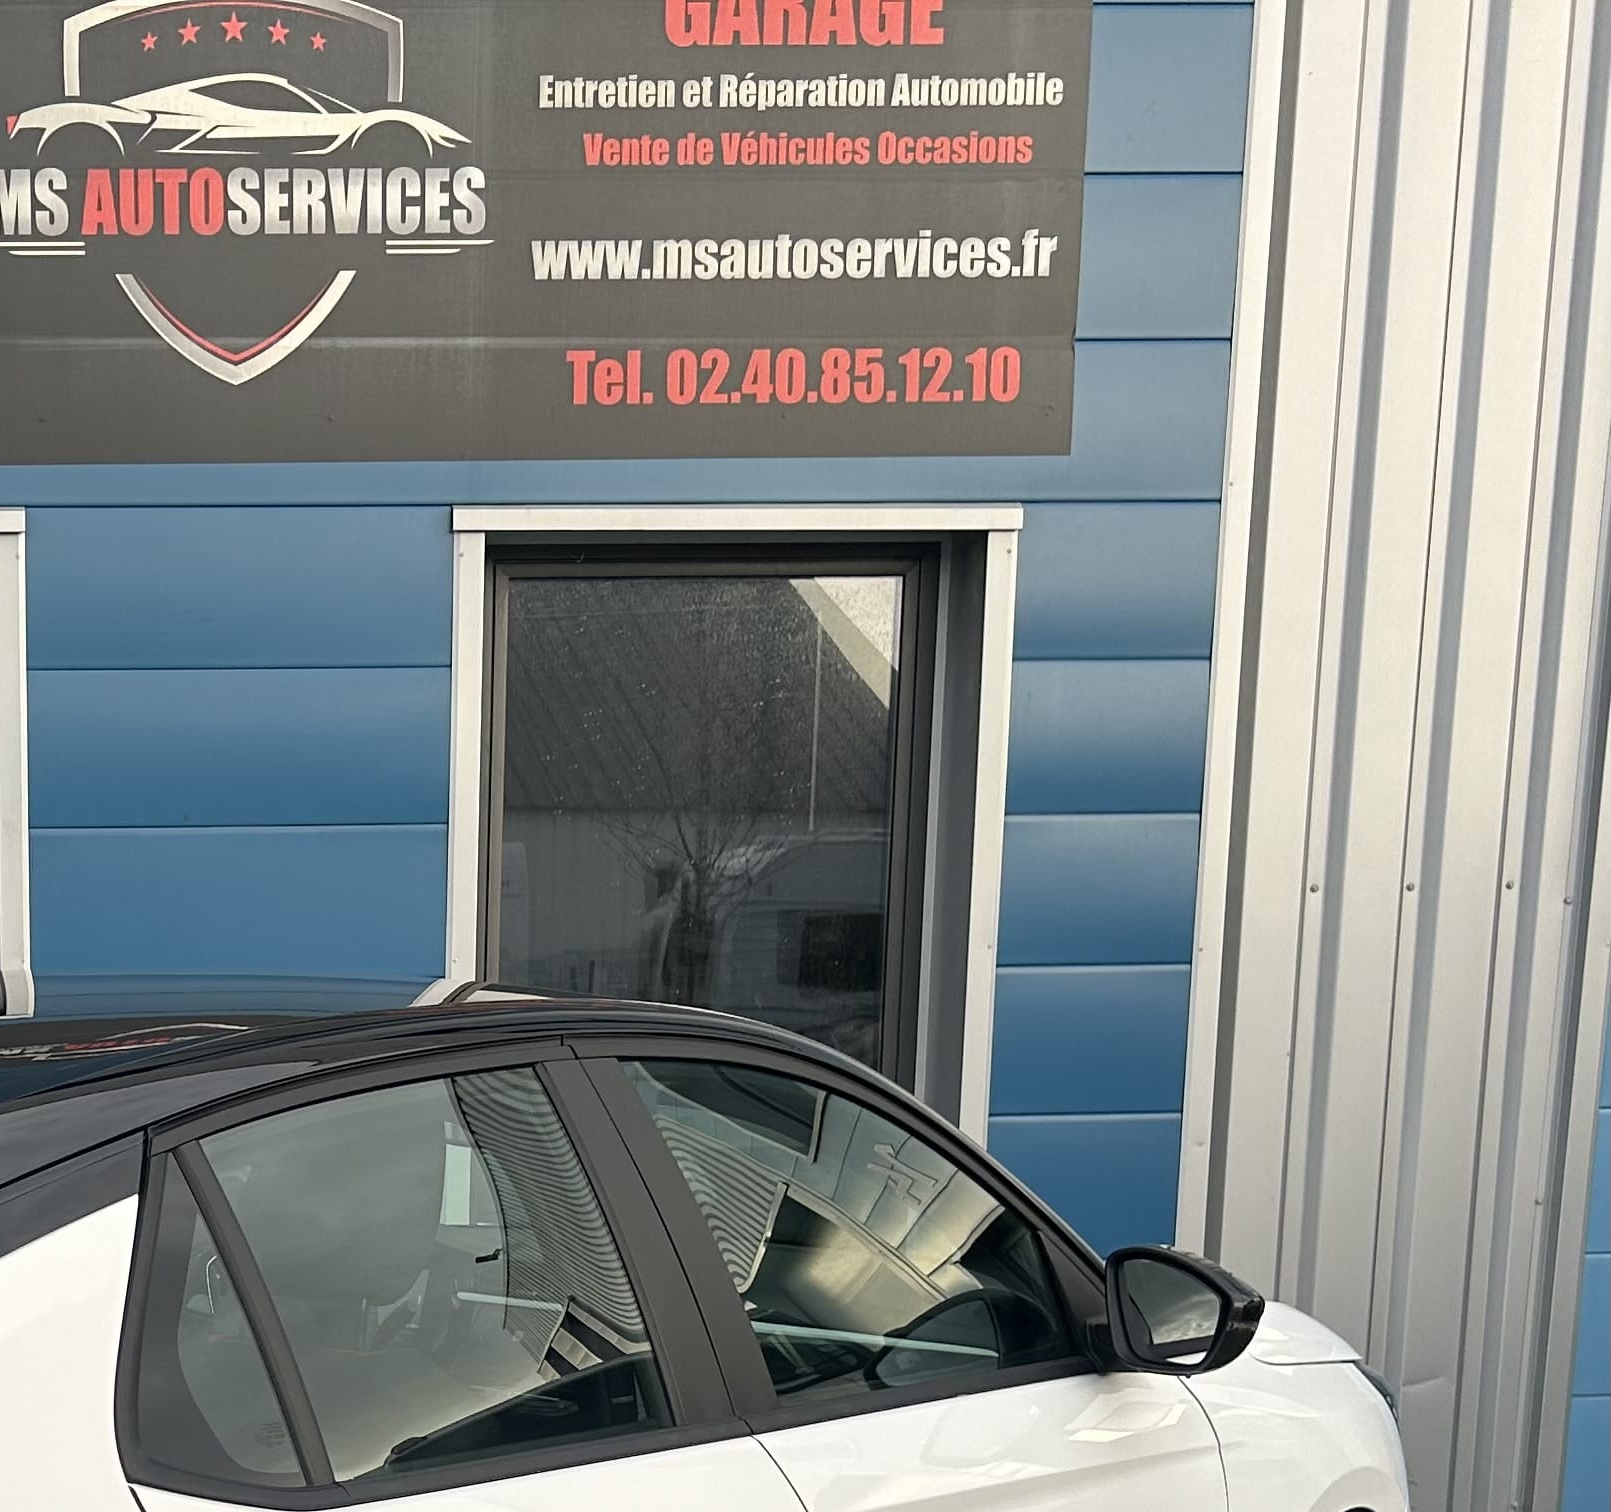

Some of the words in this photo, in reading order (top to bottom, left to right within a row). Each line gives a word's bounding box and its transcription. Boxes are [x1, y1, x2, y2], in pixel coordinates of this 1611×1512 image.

[665, 0, 945, 47] GARAGE
[538, 74, 676, 109] Entretien
[682, 78, 713, 109] et
[719, 72, 885, 111] Réparation
[891, 72, 1064, 108] Automobile
[583, 132, 670, 167] Vente
[677, 133, 714, 166] de
[720, 130, 871, 166] Véhicules
[877, 130, 1033, 164] Occasions
[81, 165, 487, 236] AUTOSERVICES
[531, 229, 1058, 281] www.msautoservices.fr
[566, 350, 654, 405] Tel.
[666, 346, 1022, 404] 02.40.85.12.10
